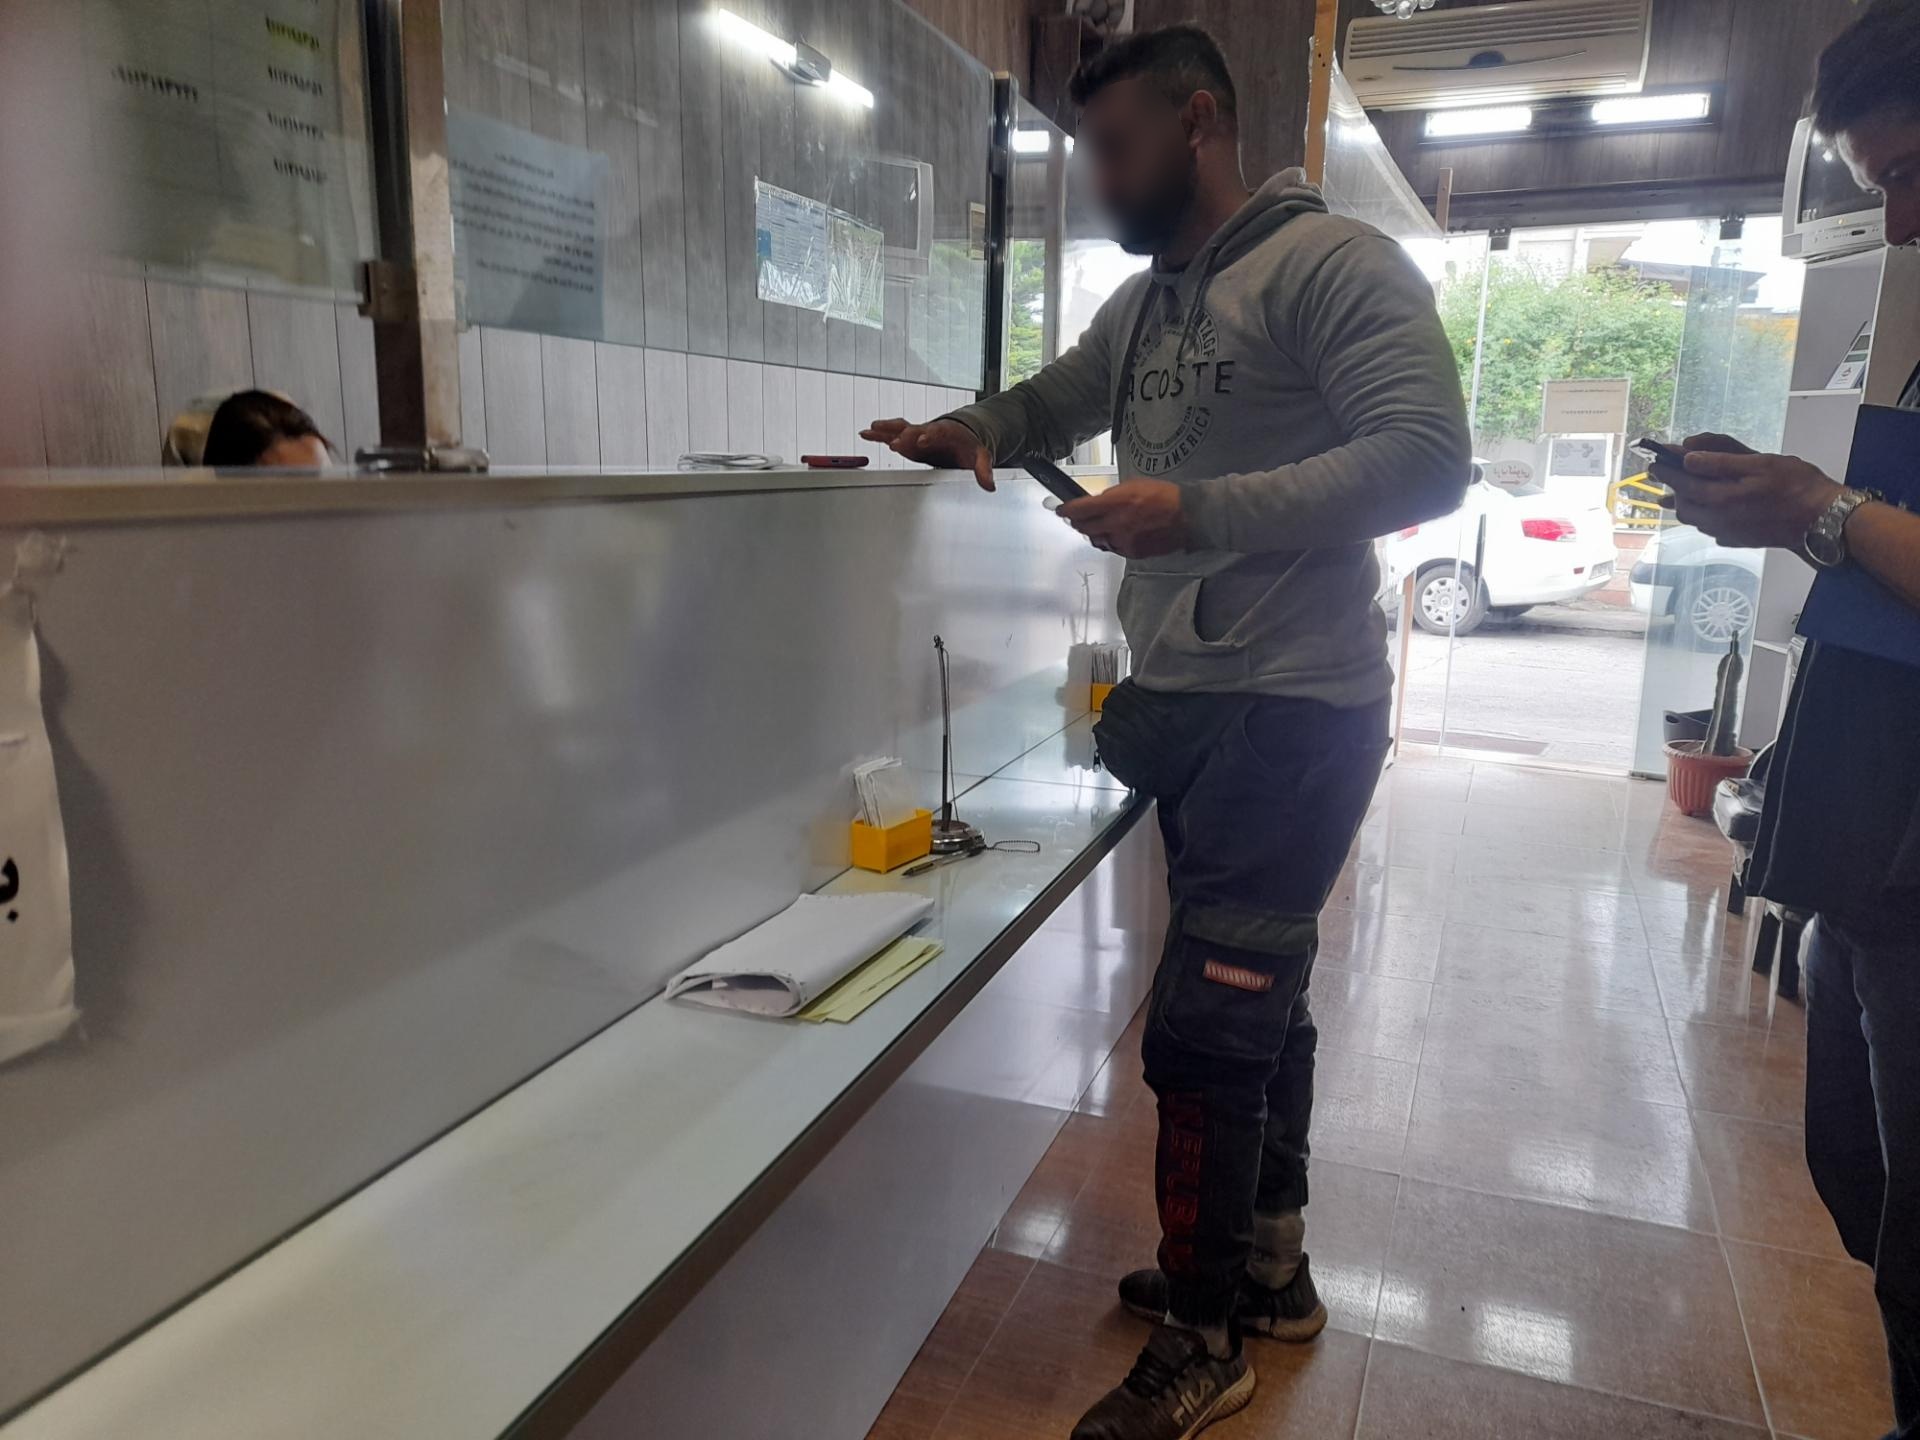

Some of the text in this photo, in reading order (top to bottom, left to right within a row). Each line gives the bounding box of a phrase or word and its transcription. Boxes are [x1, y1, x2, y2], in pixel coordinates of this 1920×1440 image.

[1129, 360, 1236, 403] COSTE
[1145, 456, 1159, 473] OF
[1163, 405, 1212, 470] AMERICA
